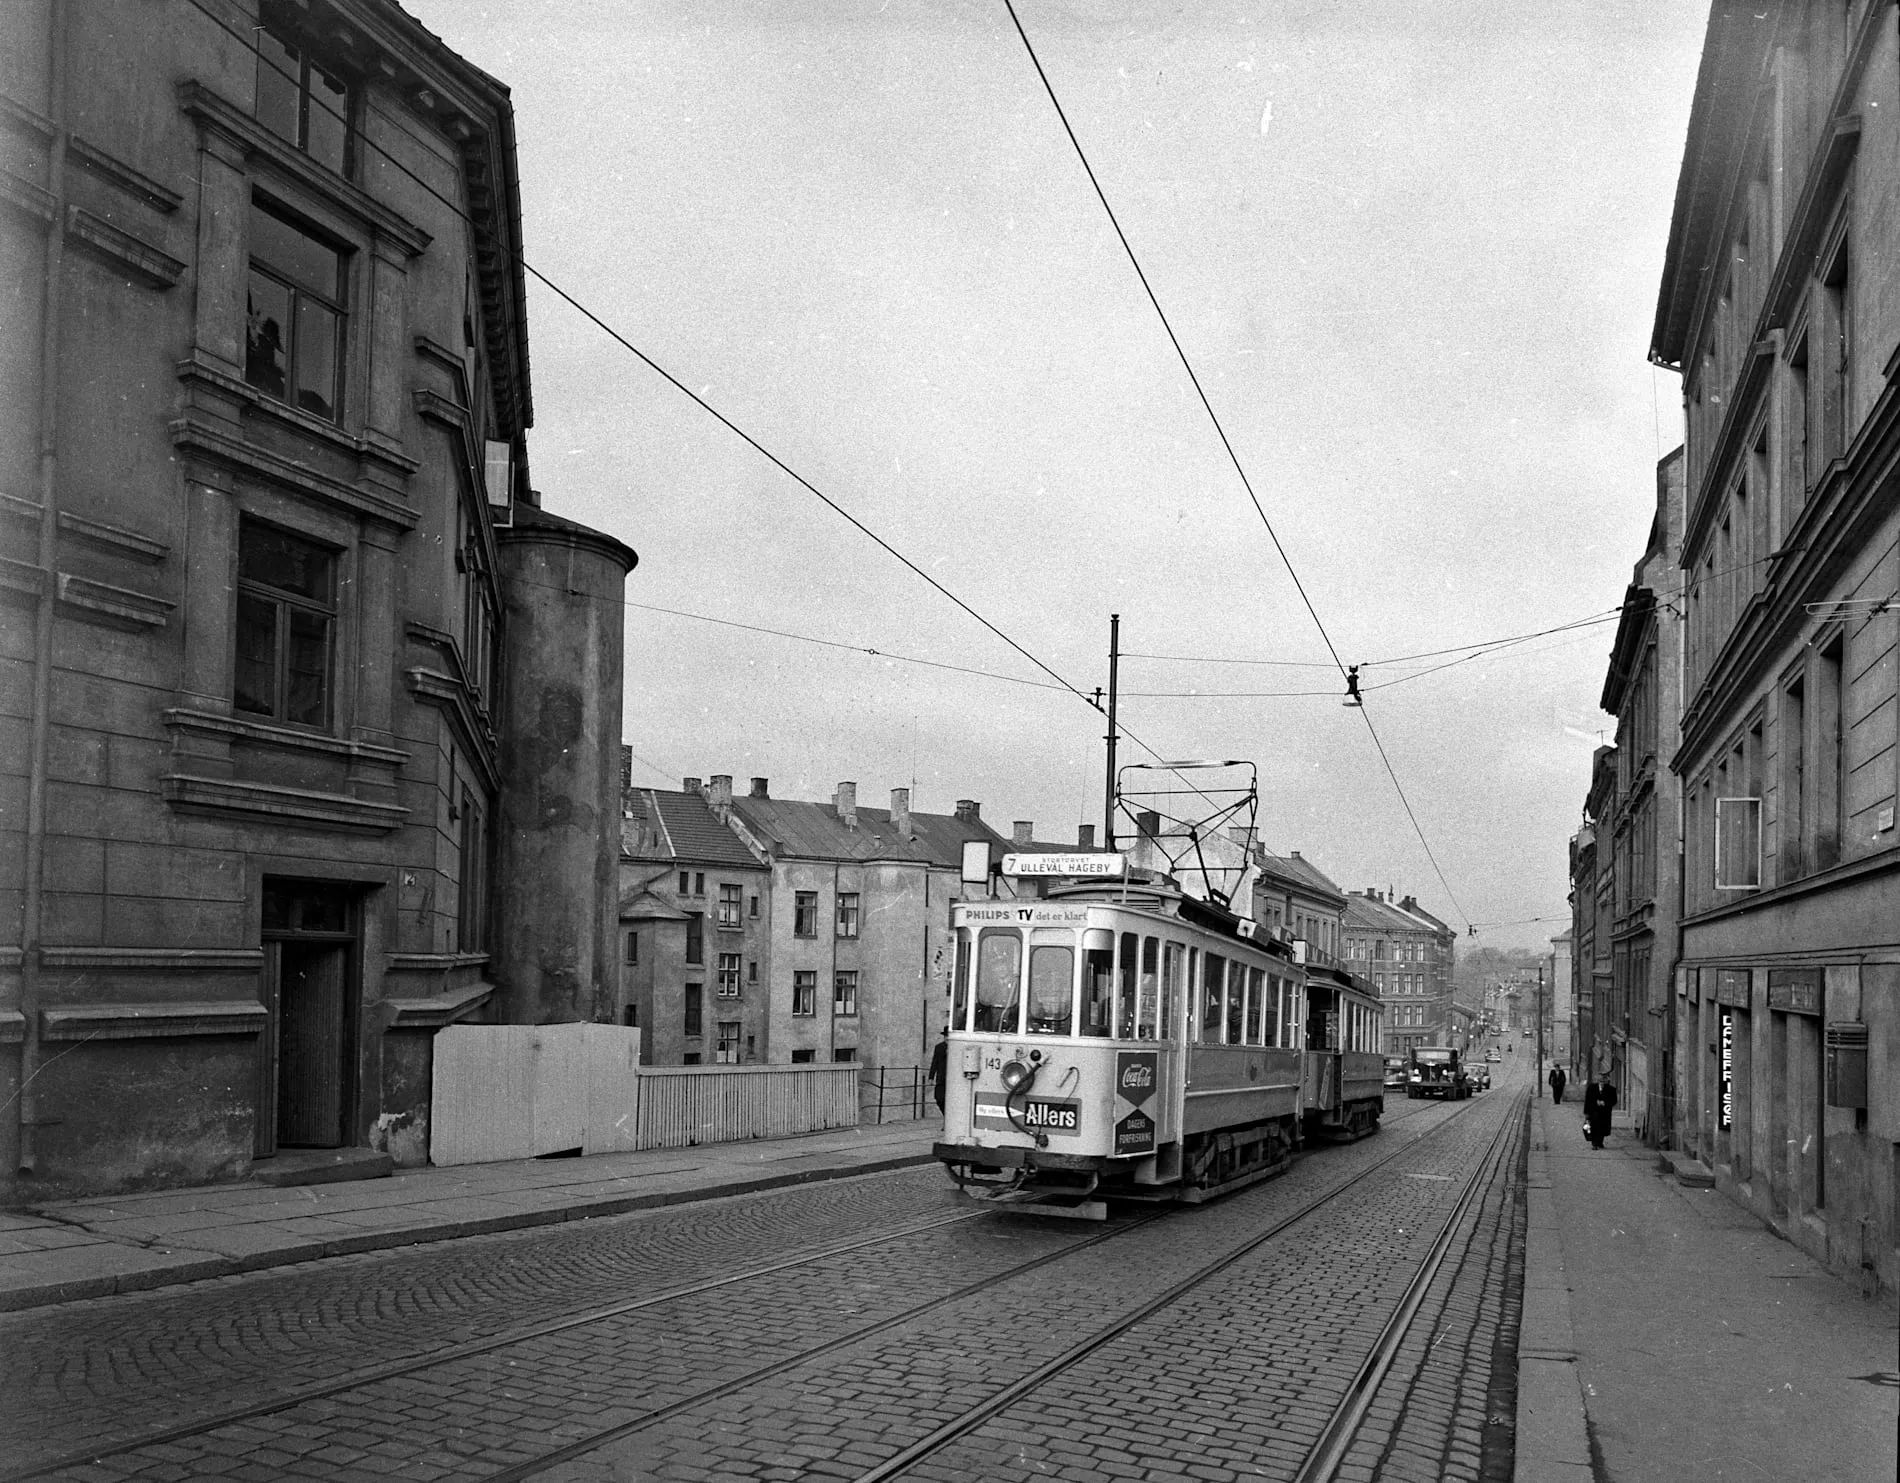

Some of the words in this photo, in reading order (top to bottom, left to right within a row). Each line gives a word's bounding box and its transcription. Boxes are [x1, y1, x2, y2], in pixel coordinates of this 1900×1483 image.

[1007, 858, 1017, 872] 7
[1068, 863, 1111, 873] HAGEBY
[966, 910, 1010, 920] PHILIPS
[1017, 908, 1034, 921] TV
[1036, 911, 1050, 921] det
[1052, 913, 1063, 921] er
[1064, 911, 1088, 921] klart
[985, 1057, 1001, 1070] 143
[1026, 1103, 1076, 1127] Allers
